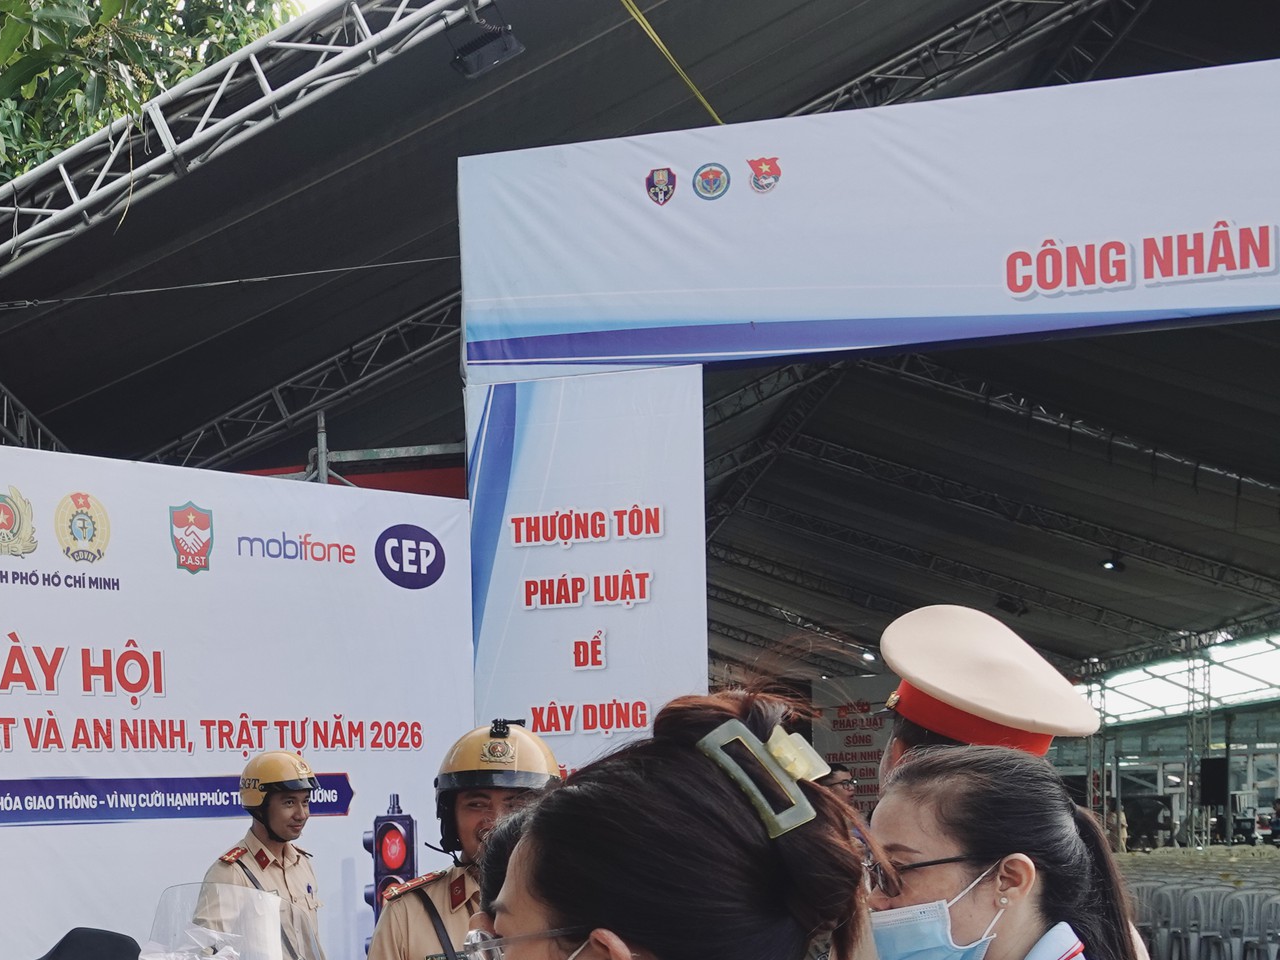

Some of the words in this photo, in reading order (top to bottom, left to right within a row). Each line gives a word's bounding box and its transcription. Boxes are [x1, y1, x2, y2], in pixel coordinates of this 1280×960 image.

[1006, 238, 1126, 294] CÔNG
[1143, 220, 1270, 279] NHÂN
[511, 509, 606, 545] THƯỢNG
[614, 504, 660, 537] TÔN
[237, 531, 356, 566] mobifone
[384, 537, 436, 575] CEP
[12, 569, 39, 586] PHỐ
[42, 571, 60, 587] HỒ
[64, 573, 86, 589] CHÍ
[89, 577, 120, 591] MINH
[525, 574, 585, 606] PHÁP
[594, 569, 649, 605] LUẬT
[573, 630, 603, 667] ĐỂ
[81, 639, 164, 707] HỘI
[531, 701, 575, 733] XÂY
[582, 698, 647, 734] DỰNG
[24, 710, 61, 750] VÀ
[72, 719, 113, 750] AN
[120, 719, 193, 754] NINH,
[200, 714, 268, 760] TRẬT
[275, 716, 308, 756] TỰ
[313, 714, 363, 749] NĂM
[371, 720, 422, 749] 2026
[24, 795, 53, 810] GIAO
[54, 791, 97, 809] THÔNG
[107, 790, 119, 808] VÌ
[120, 794, 137, 812] NỤ
[138, 790, 164, 807] CƯỜI
[168, 791, 198, 811] HẠNH
[200, 787, 230, 805] PHÚC
